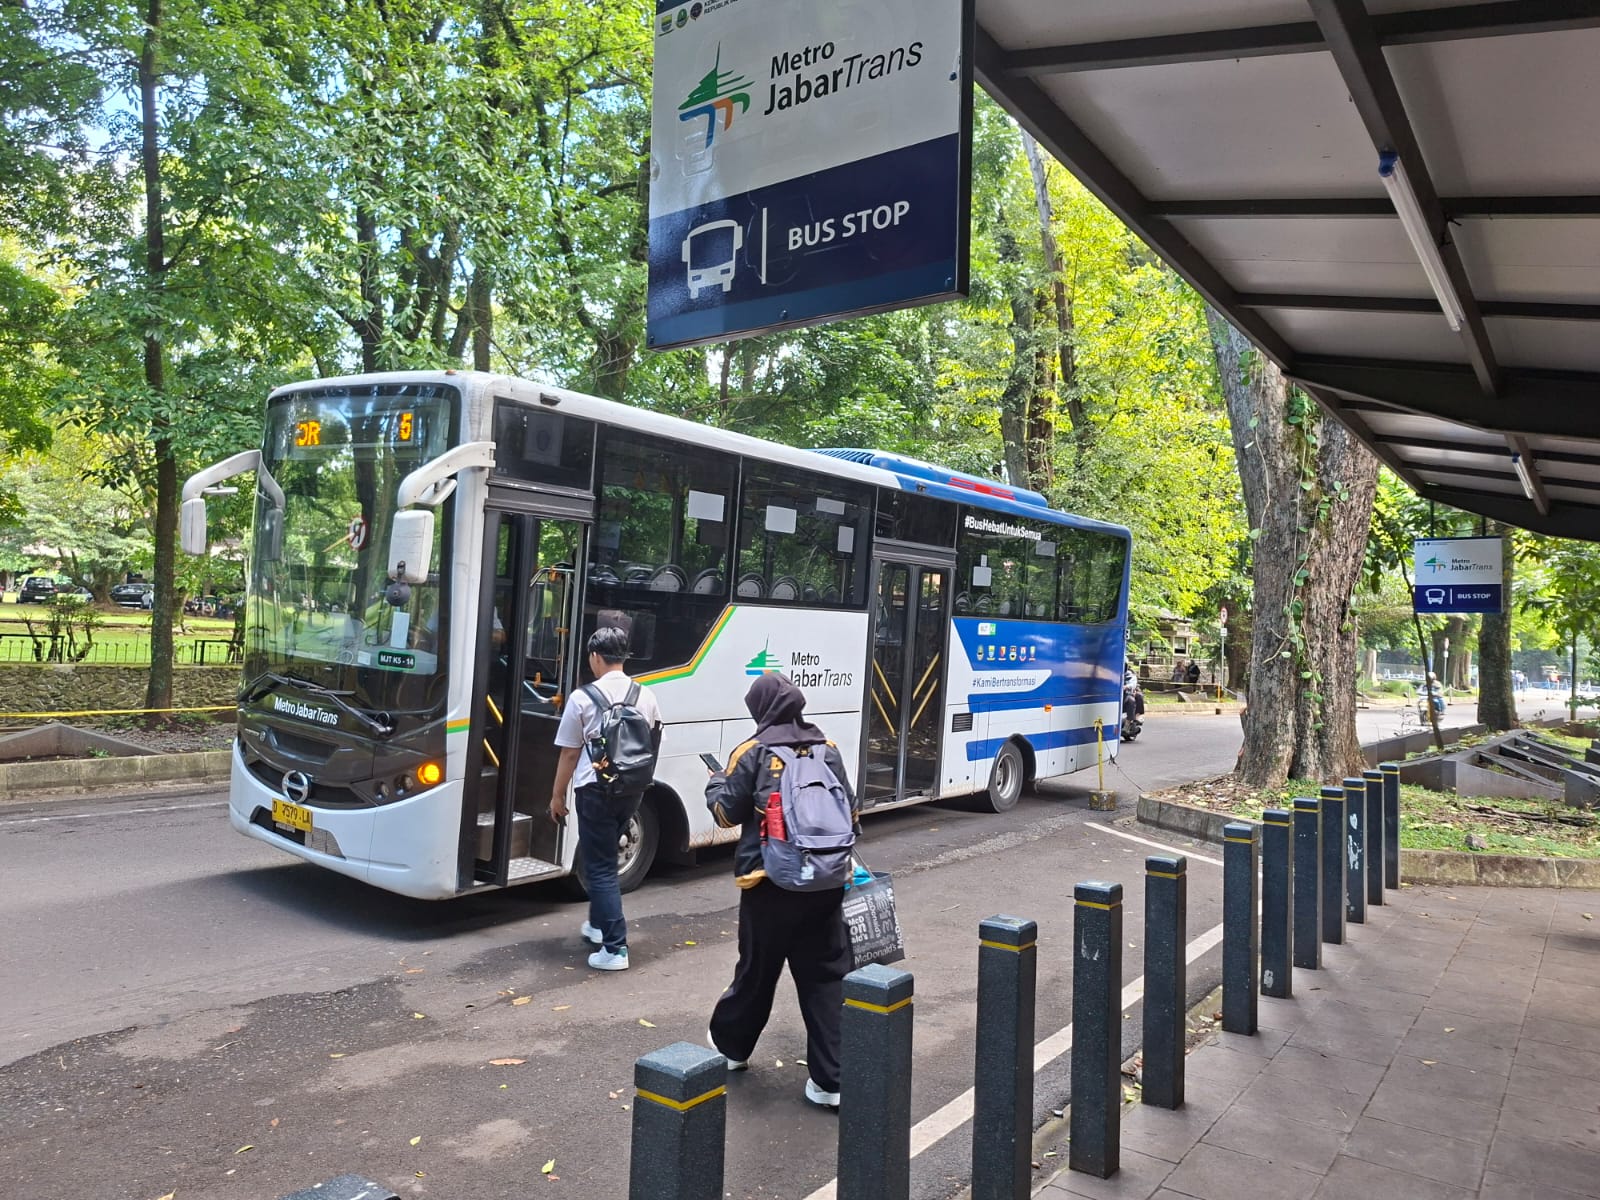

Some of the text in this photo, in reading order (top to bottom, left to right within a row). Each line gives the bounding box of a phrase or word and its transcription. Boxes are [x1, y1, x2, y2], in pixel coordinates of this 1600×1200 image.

[770, 41, 835, 79] Metro
[764, 41, 923, 116] JabarTrans
[788, 200, 910, 251] BUS STOP
[964, 515, 1042, 540] #BusHebatUntukSemua
[791, 652, 820, 666] Metro
[972, 675, 1037, 688] #KamiBertransformasi
[848, 916, 865, 926] McD
[850, 923, 867, 936] on
